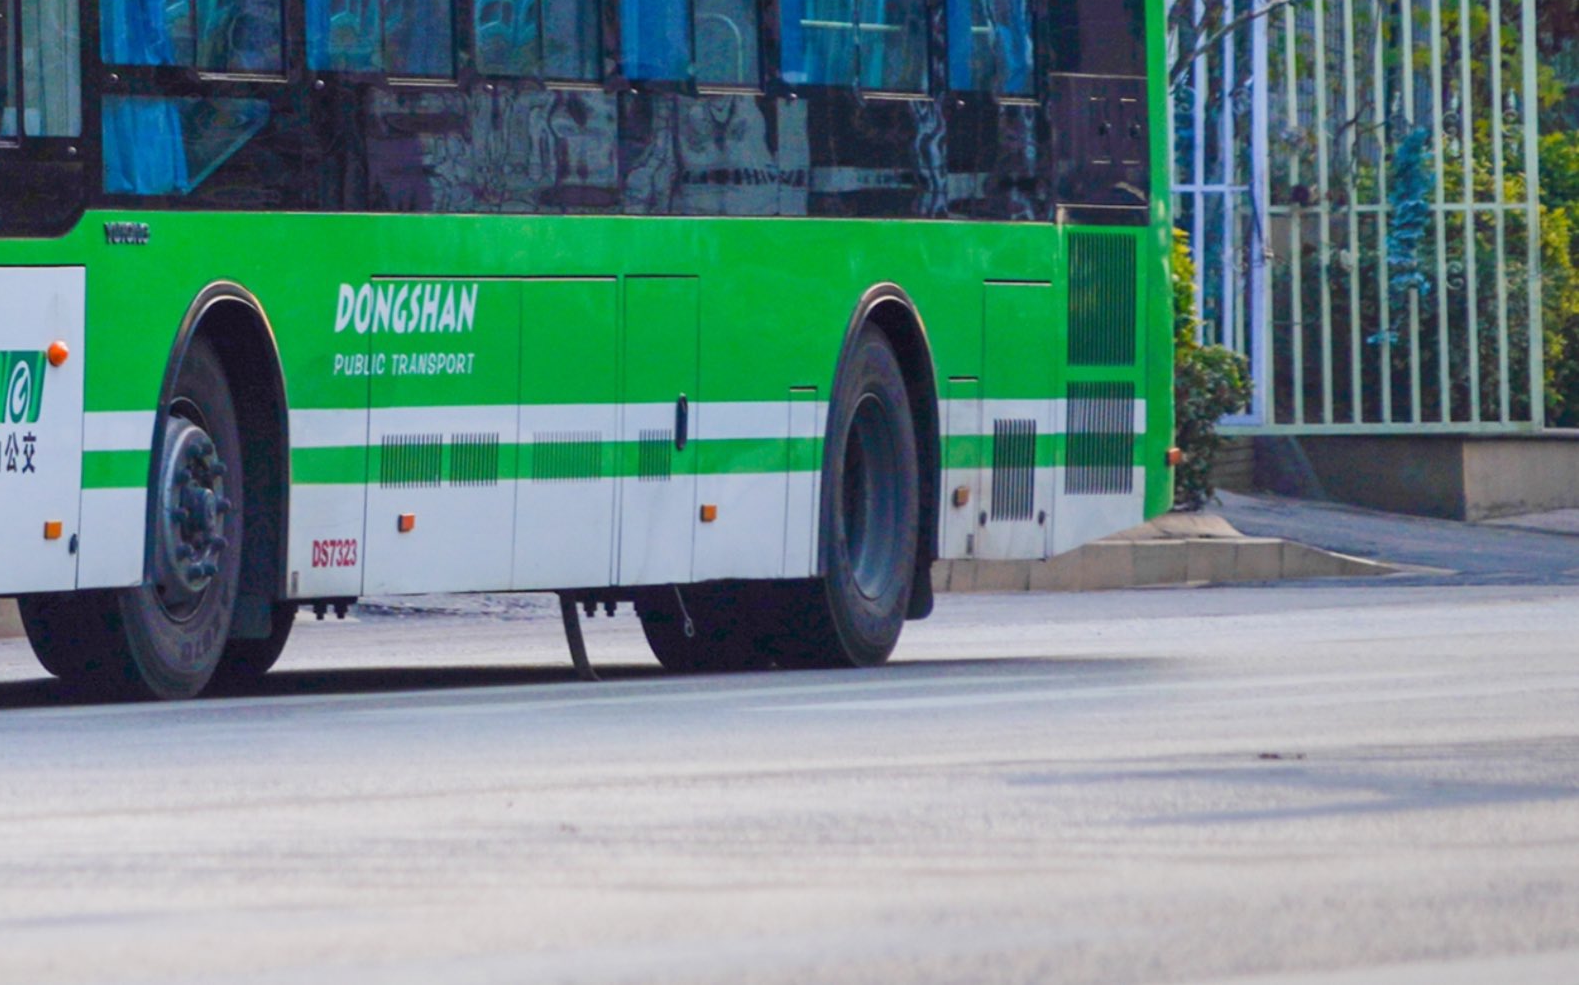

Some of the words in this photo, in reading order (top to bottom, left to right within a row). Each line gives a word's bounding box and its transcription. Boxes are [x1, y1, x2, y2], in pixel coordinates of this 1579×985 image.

[333, 283, 479, 334] DONGSHAN
[333, 353, 387, 375] PUBLIC
[391, 352, 476, 375] TRANSPORT
[311, 538, 358, 567] DS7323
